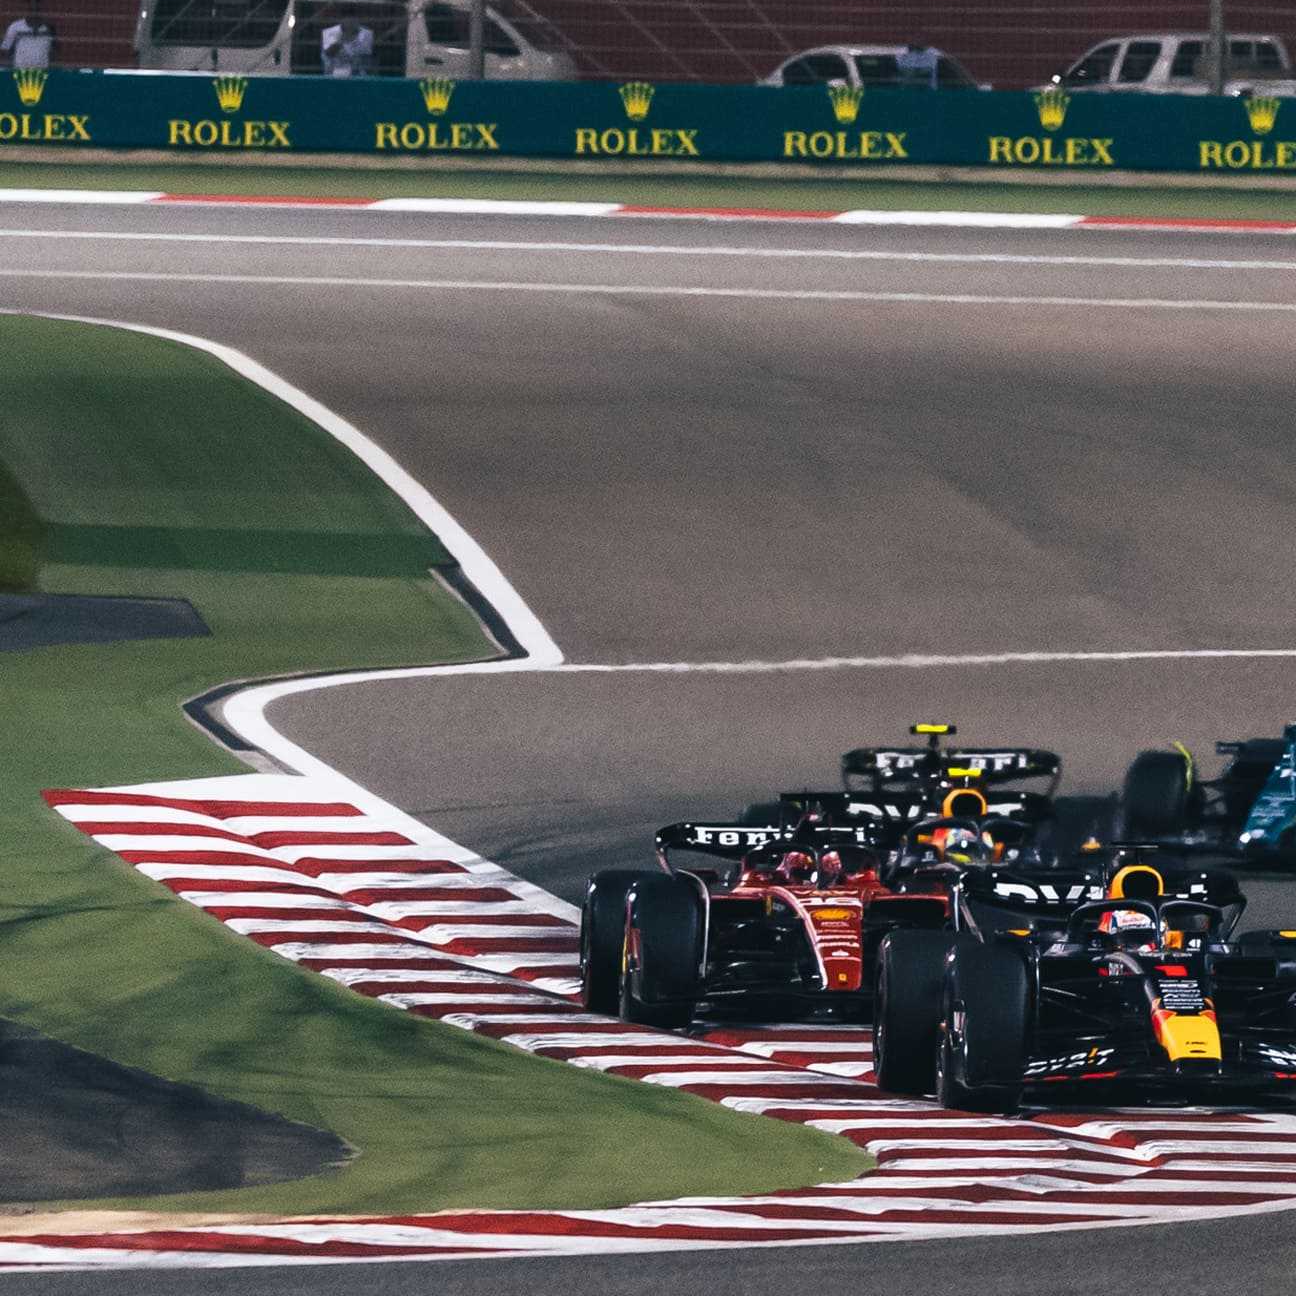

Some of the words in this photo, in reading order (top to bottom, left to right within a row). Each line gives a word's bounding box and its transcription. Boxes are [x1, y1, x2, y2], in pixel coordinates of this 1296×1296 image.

[169, 119, 289, 147] ROLEX
[376, 123, 498, 149] ROLEX
[576, 128, 697, 155] ROLEX
[784, 131, 907, 158] ROLEX
[989, 137, 1113, 165] ROLEX
